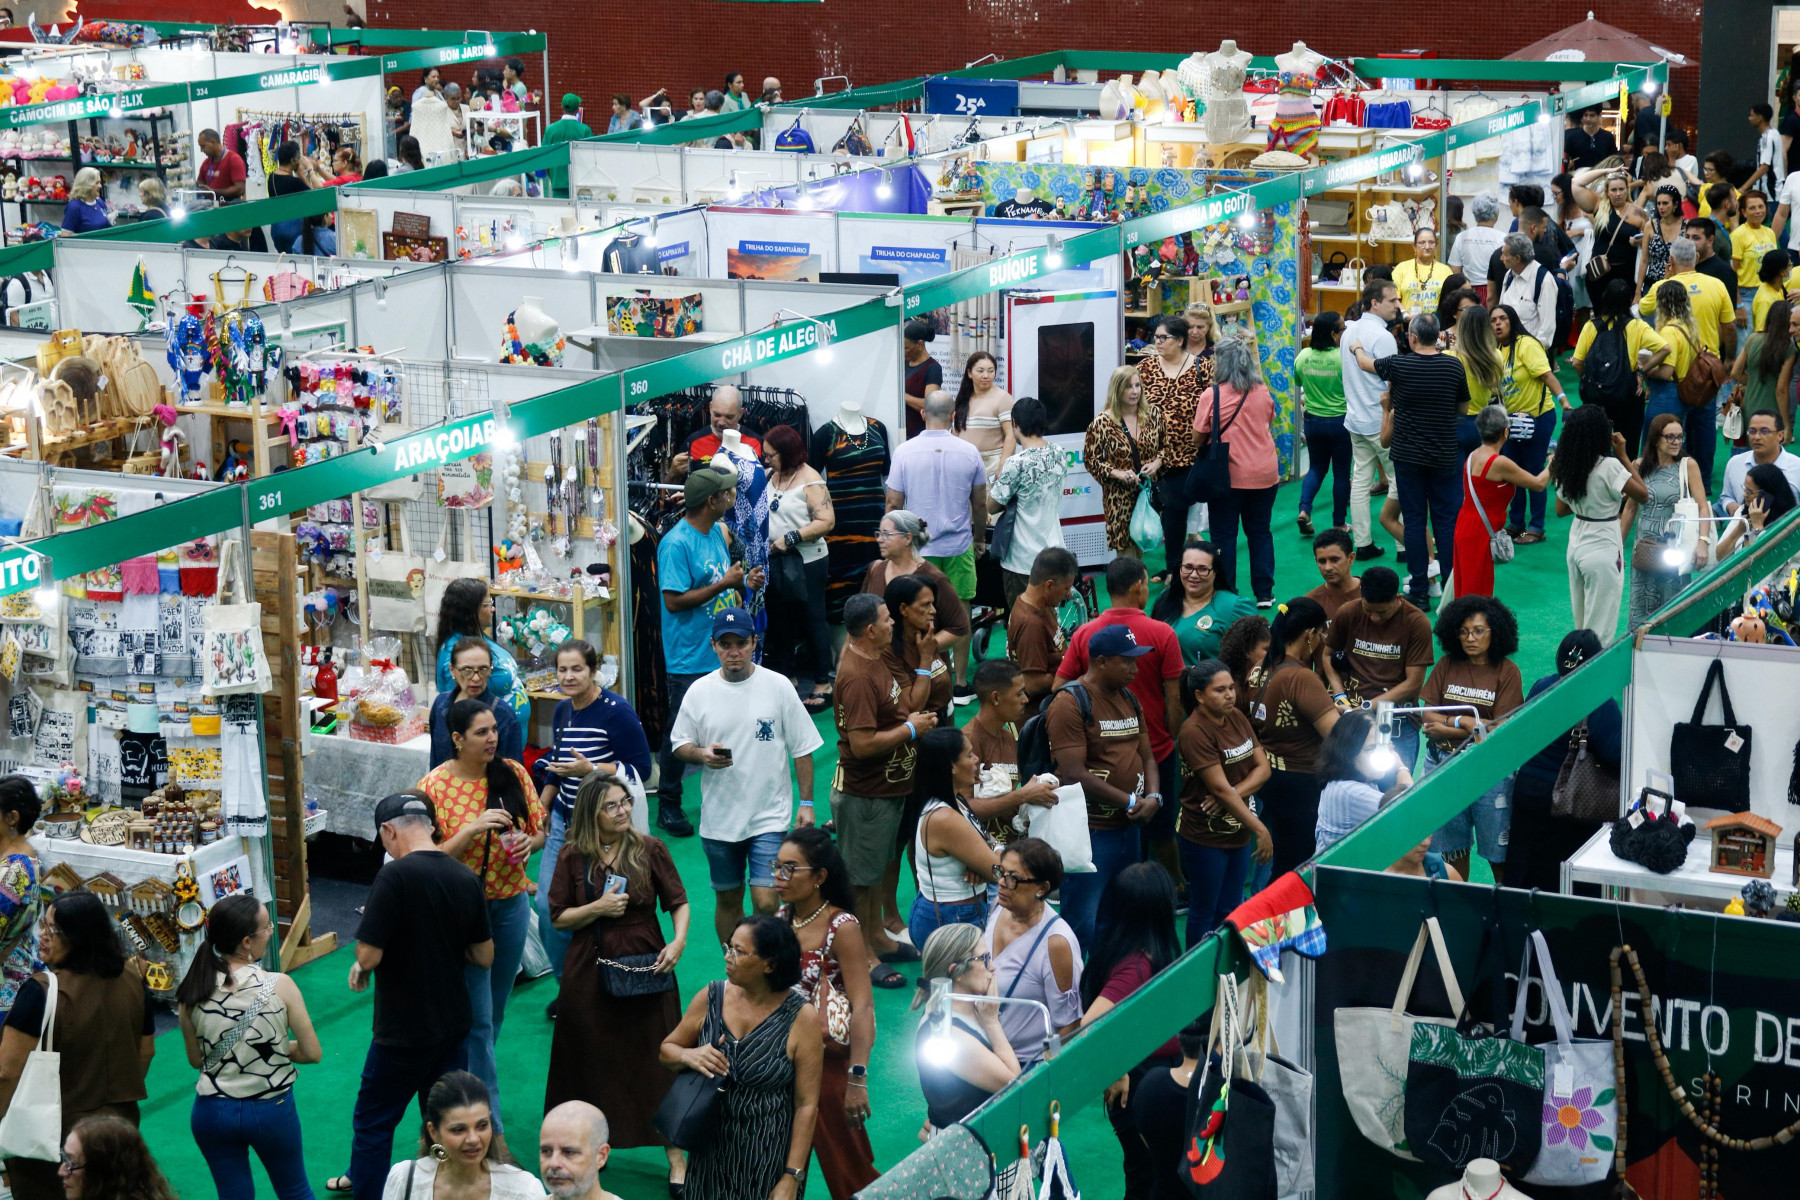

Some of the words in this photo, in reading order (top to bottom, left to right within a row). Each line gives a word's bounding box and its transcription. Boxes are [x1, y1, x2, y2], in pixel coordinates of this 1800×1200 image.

[440, 49, 459, 62] BOM
[261, 67, 325, 88] CAMARAGIB
[196, 87, 208, 97] 334
[10, 103, 66, 123] CAMOCIM
[68, 101, 84, 117] DE
[86, 95, 110, 113] SÃO
[1488, 115, 1507, 134] FEIRA
[1508, 110, 1525, 129] NOVA
[1209, 200, 1222, 218] DO
[1224, 195, 1250, 214] GOIT
[745, 243, 763, 251] TRILHA
[774, 244, 807, 254] SANTUÁRIO
[875, 249, 894, 258] TRILHA
[906, 250, 940, 260] CHAPADÃO
[989, 254, 1038, 287] BUÍQUE
[906, 294, 920, 310] 359
[722, 343, 752, 370] CHÃ
[756, 337, 776, 360] DE
[630, 380, 648, 396] 360
[395, 418, 503, 472] ARAÇOIAB
[259, 490, 282, 510] 361
[1446, 684, 1496, 701] TRACUNHAÉM
[121, 918, 147, 950] BONITO
[1754, 1010, 1800, 1068] DE
